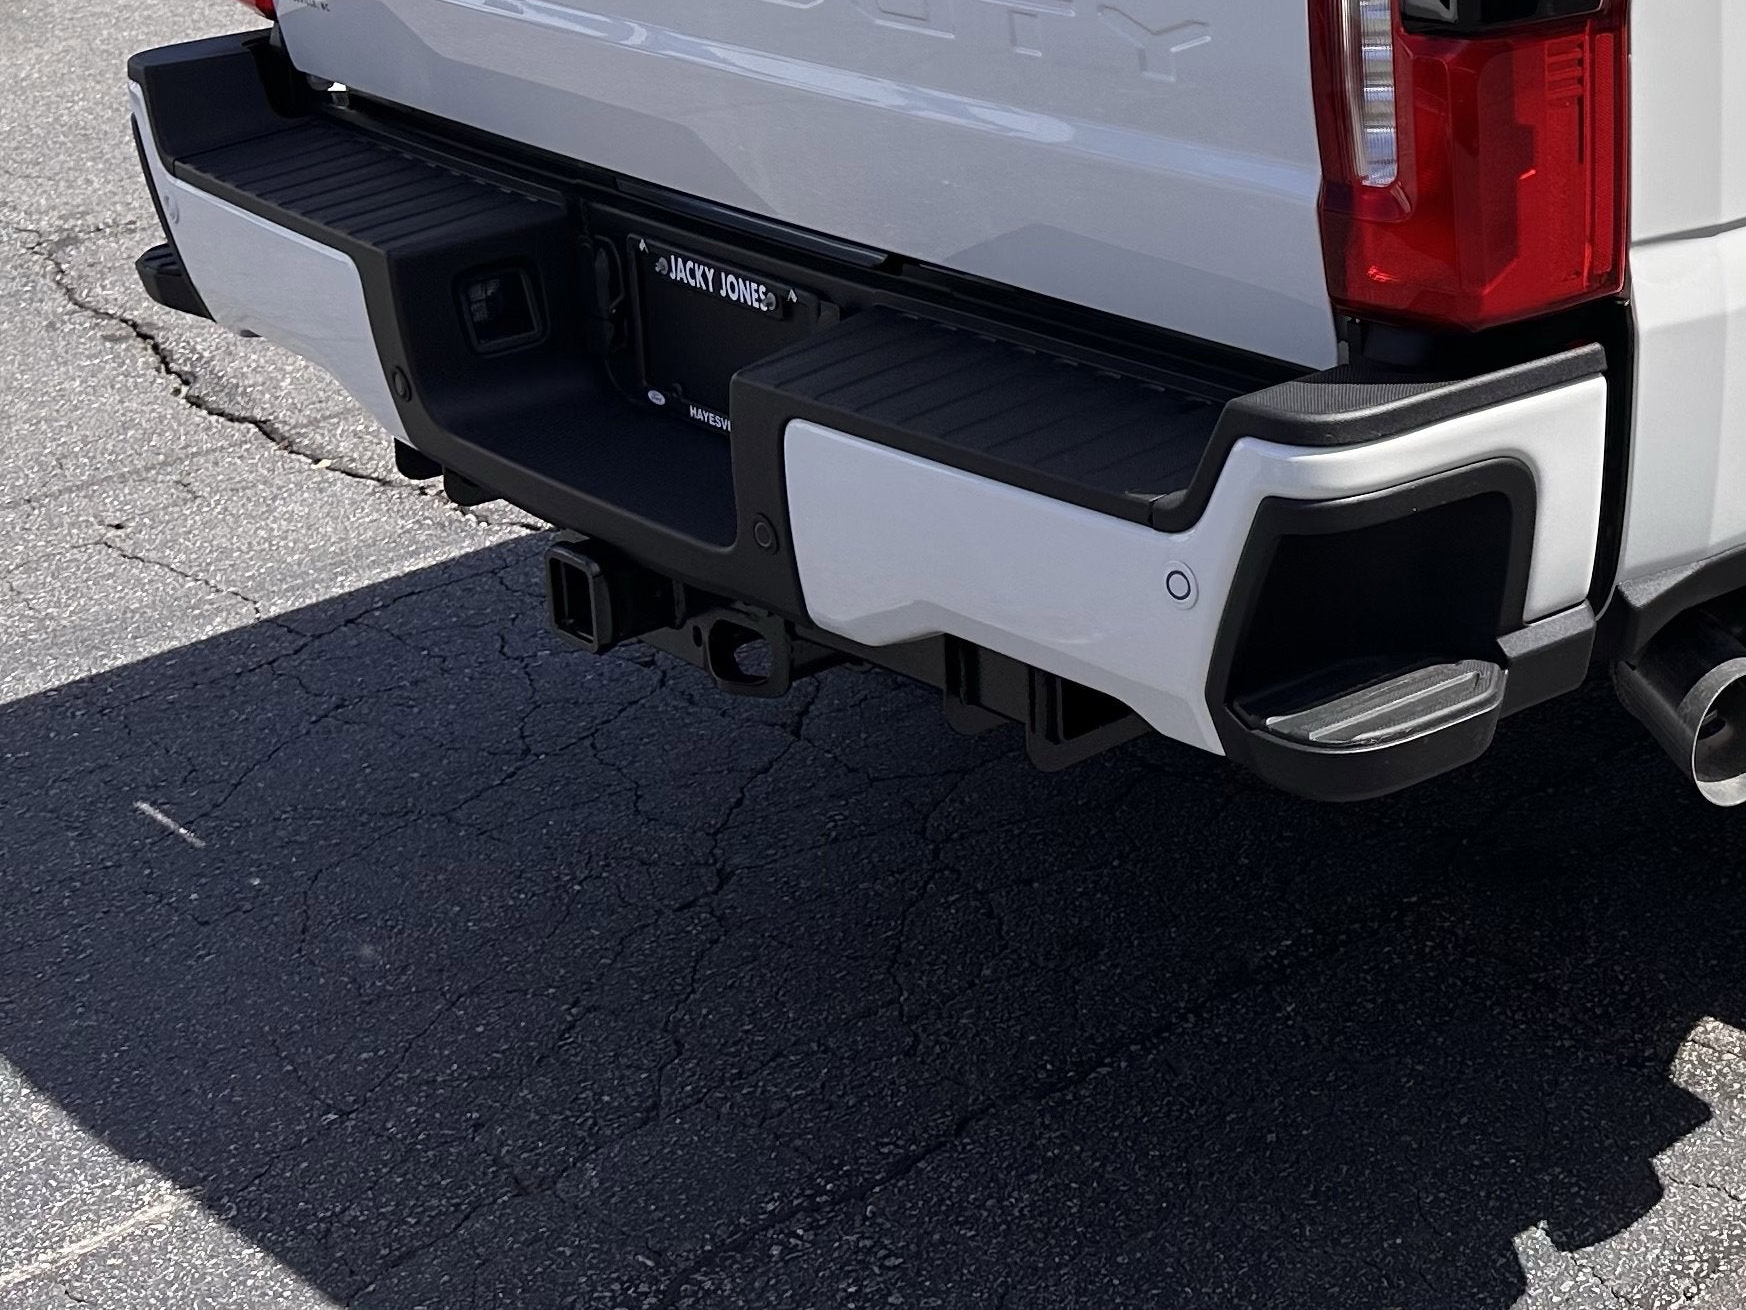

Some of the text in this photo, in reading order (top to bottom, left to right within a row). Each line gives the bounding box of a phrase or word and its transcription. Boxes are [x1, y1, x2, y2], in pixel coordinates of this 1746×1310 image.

[669, 254, 768, 312] JACKY JONES
[690, 405, 731, 433] HAYESVI
